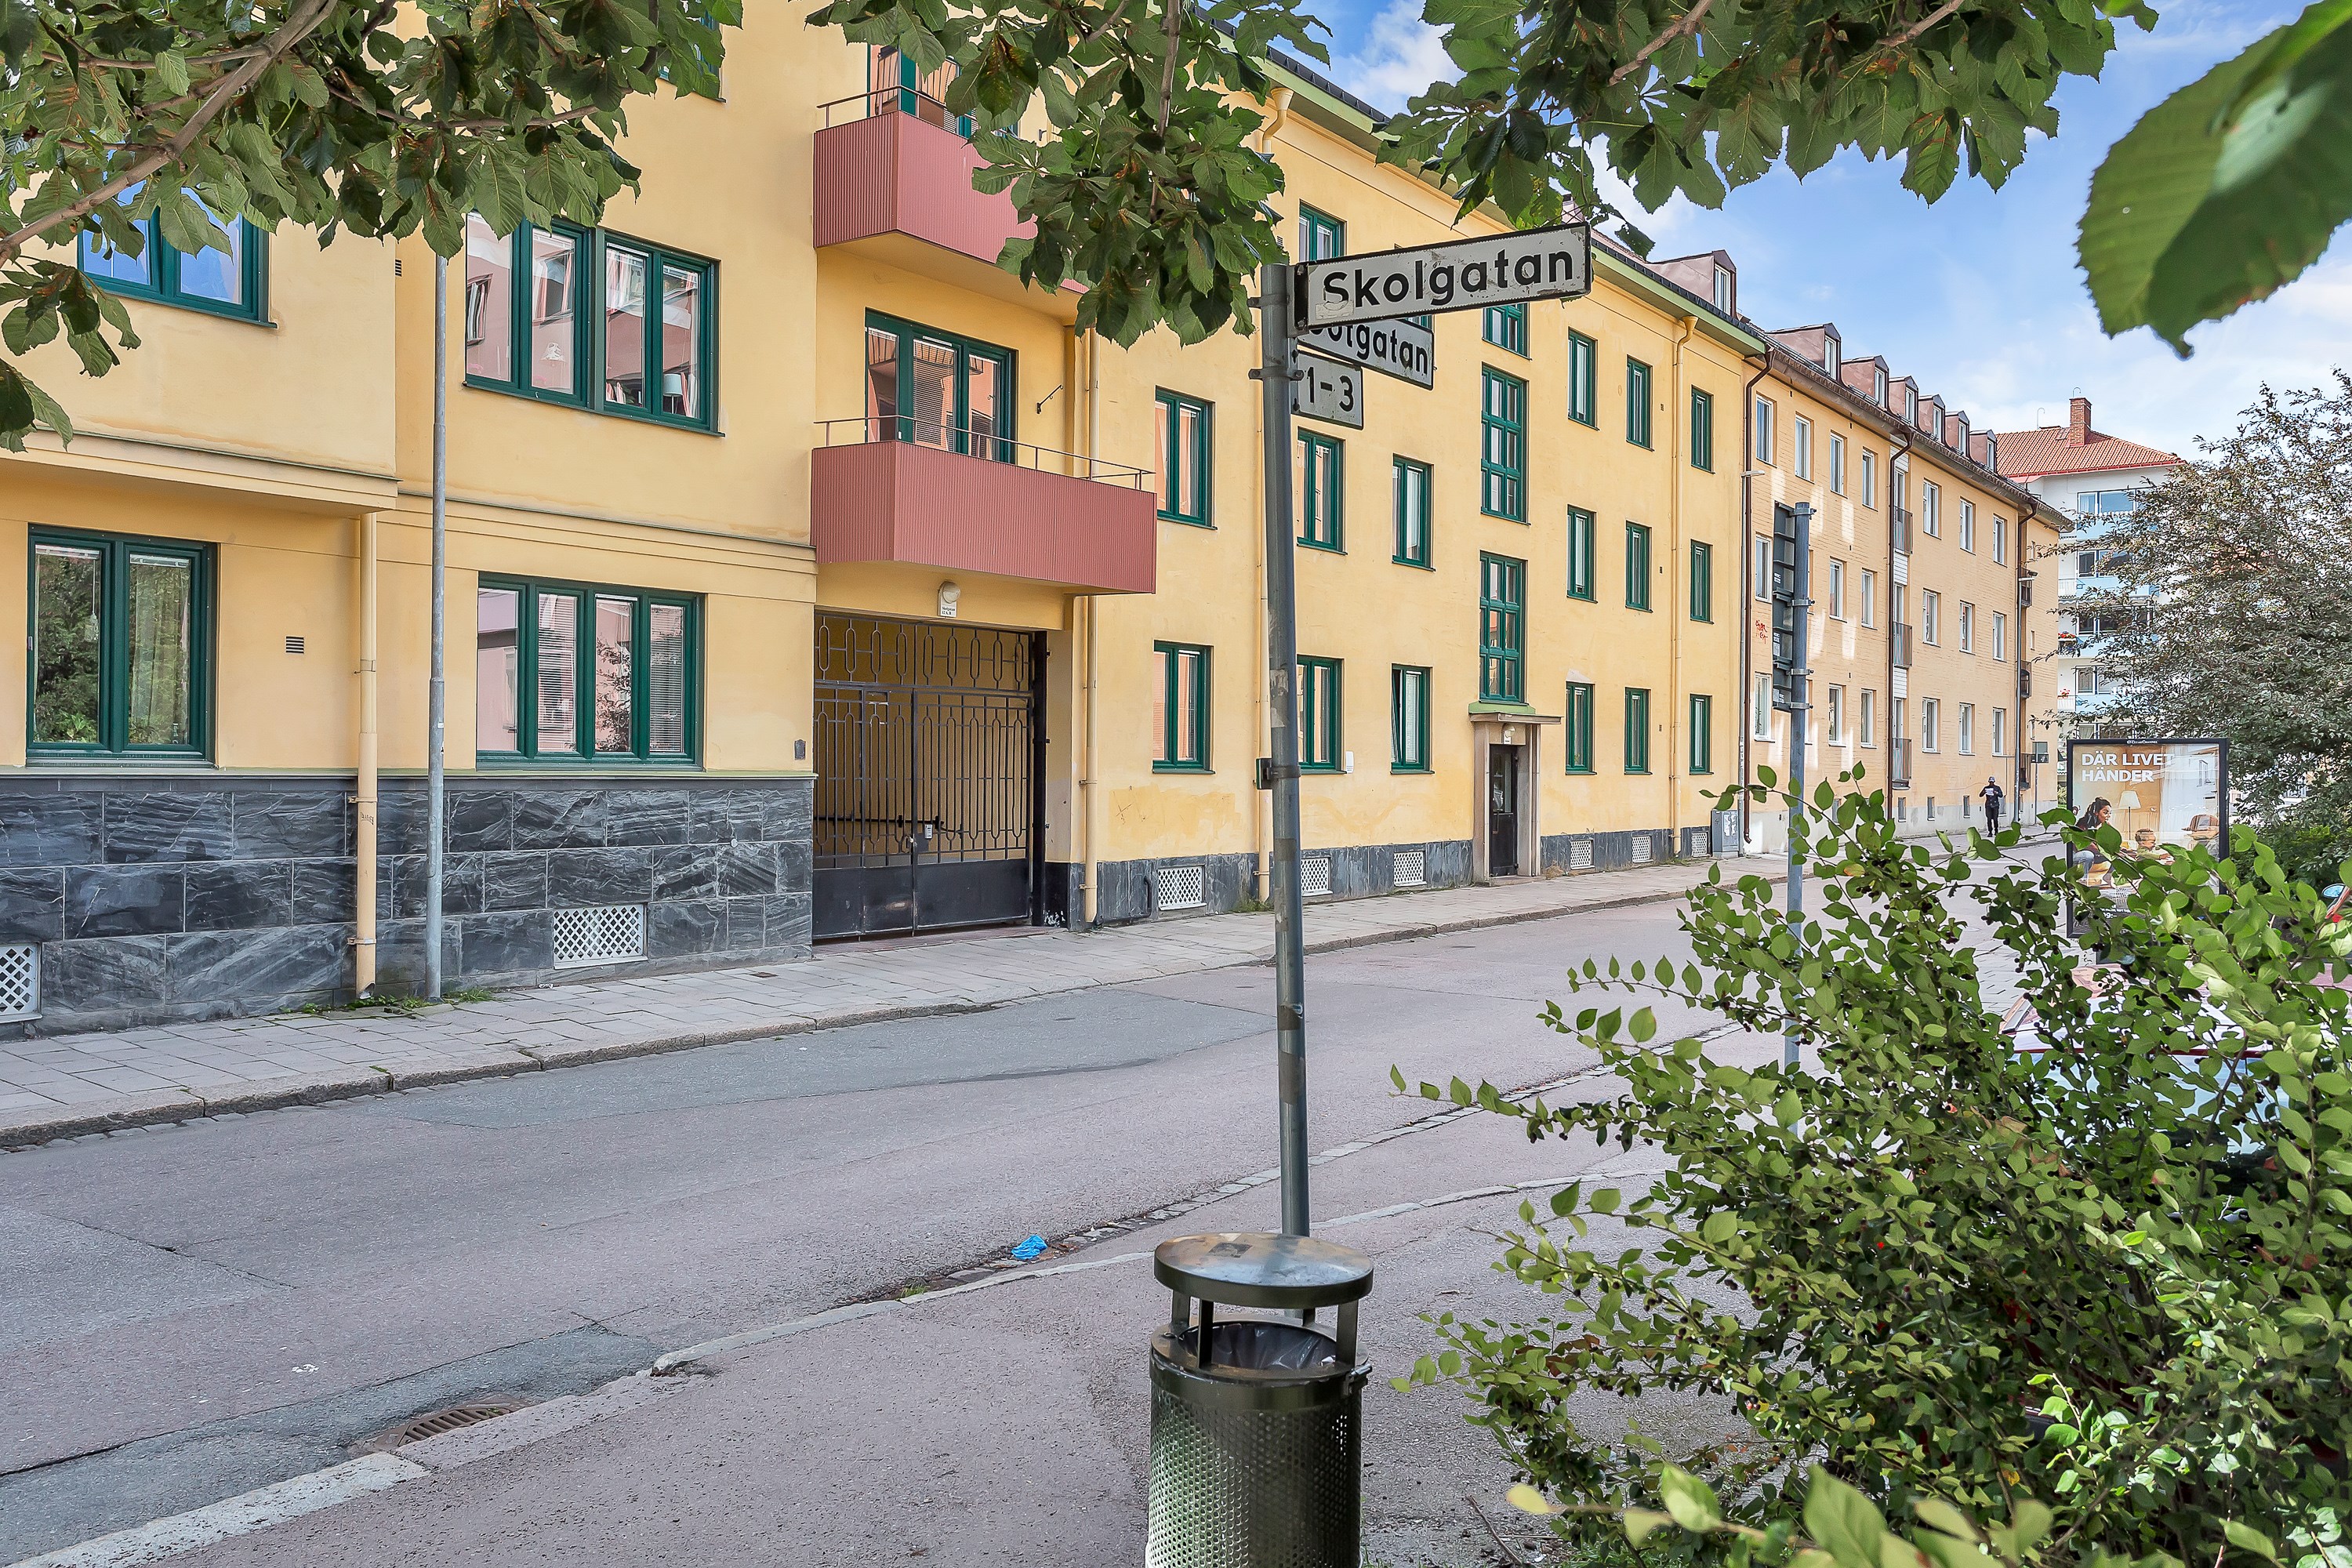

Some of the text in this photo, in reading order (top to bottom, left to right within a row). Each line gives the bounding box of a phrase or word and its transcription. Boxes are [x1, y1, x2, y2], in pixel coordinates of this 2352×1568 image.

[1323, 249, 1573, 308] Skolgatan
[1307, 366, 1354, 412] 1-3
[2082, 750, 2176, 766] DÄR LIVET
[2082, 767, 2154, 782] HÄNDER
